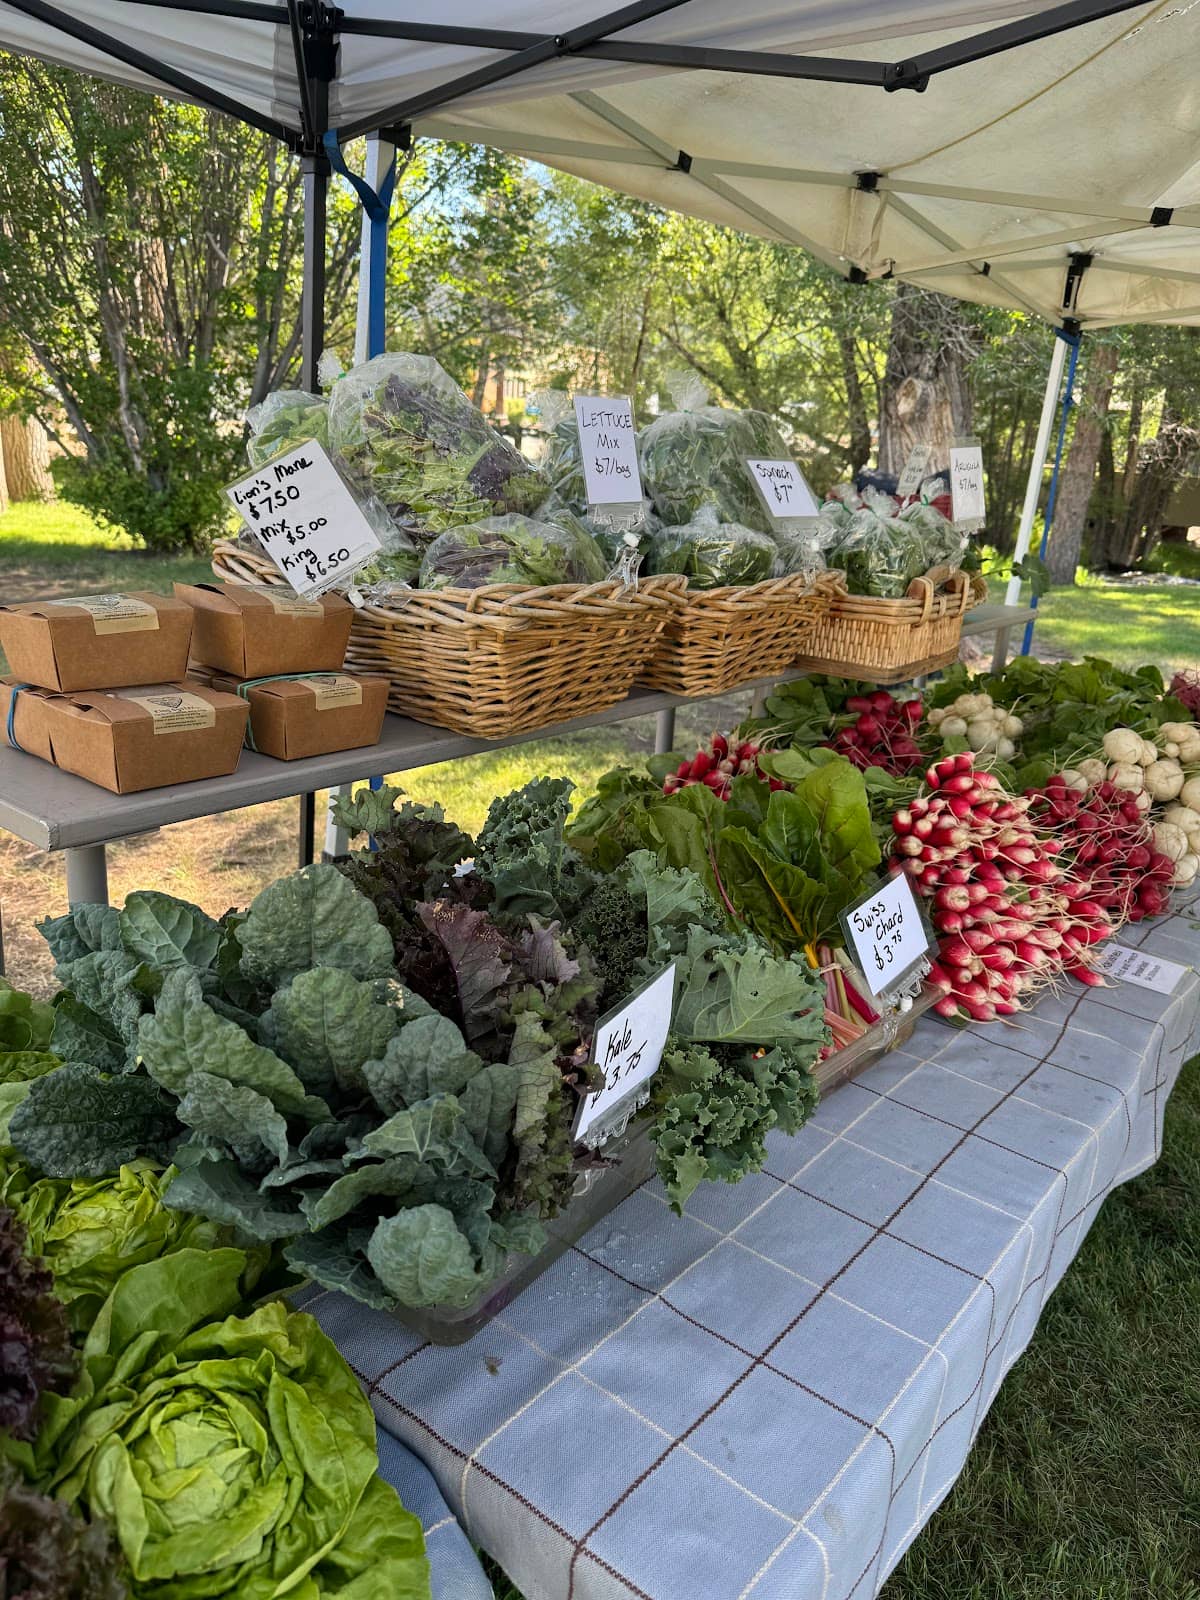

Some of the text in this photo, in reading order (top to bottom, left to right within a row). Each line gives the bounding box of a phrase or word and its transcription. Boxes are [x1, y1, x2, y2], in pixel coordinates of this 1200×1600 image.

[581, 405, 632, 429] LETTUCE
[234, 457, 313, 505] Lion's Mane
[595, 456, 631, 478] $7/bag
[249, 485, 300, 520] $7.50
[260, 518, 290, 543] Mix
[286, 517, 327, 545] $5.00
[281, 548, 318, 571] King
[305, 548, 350, 583] $6.50
[853, 901, 886, 933] Swiss
[875, 902, 903, 941] Chard
[873, 930, 902, 971] $3.75
[604, 1018, 633, 1067] Kale
